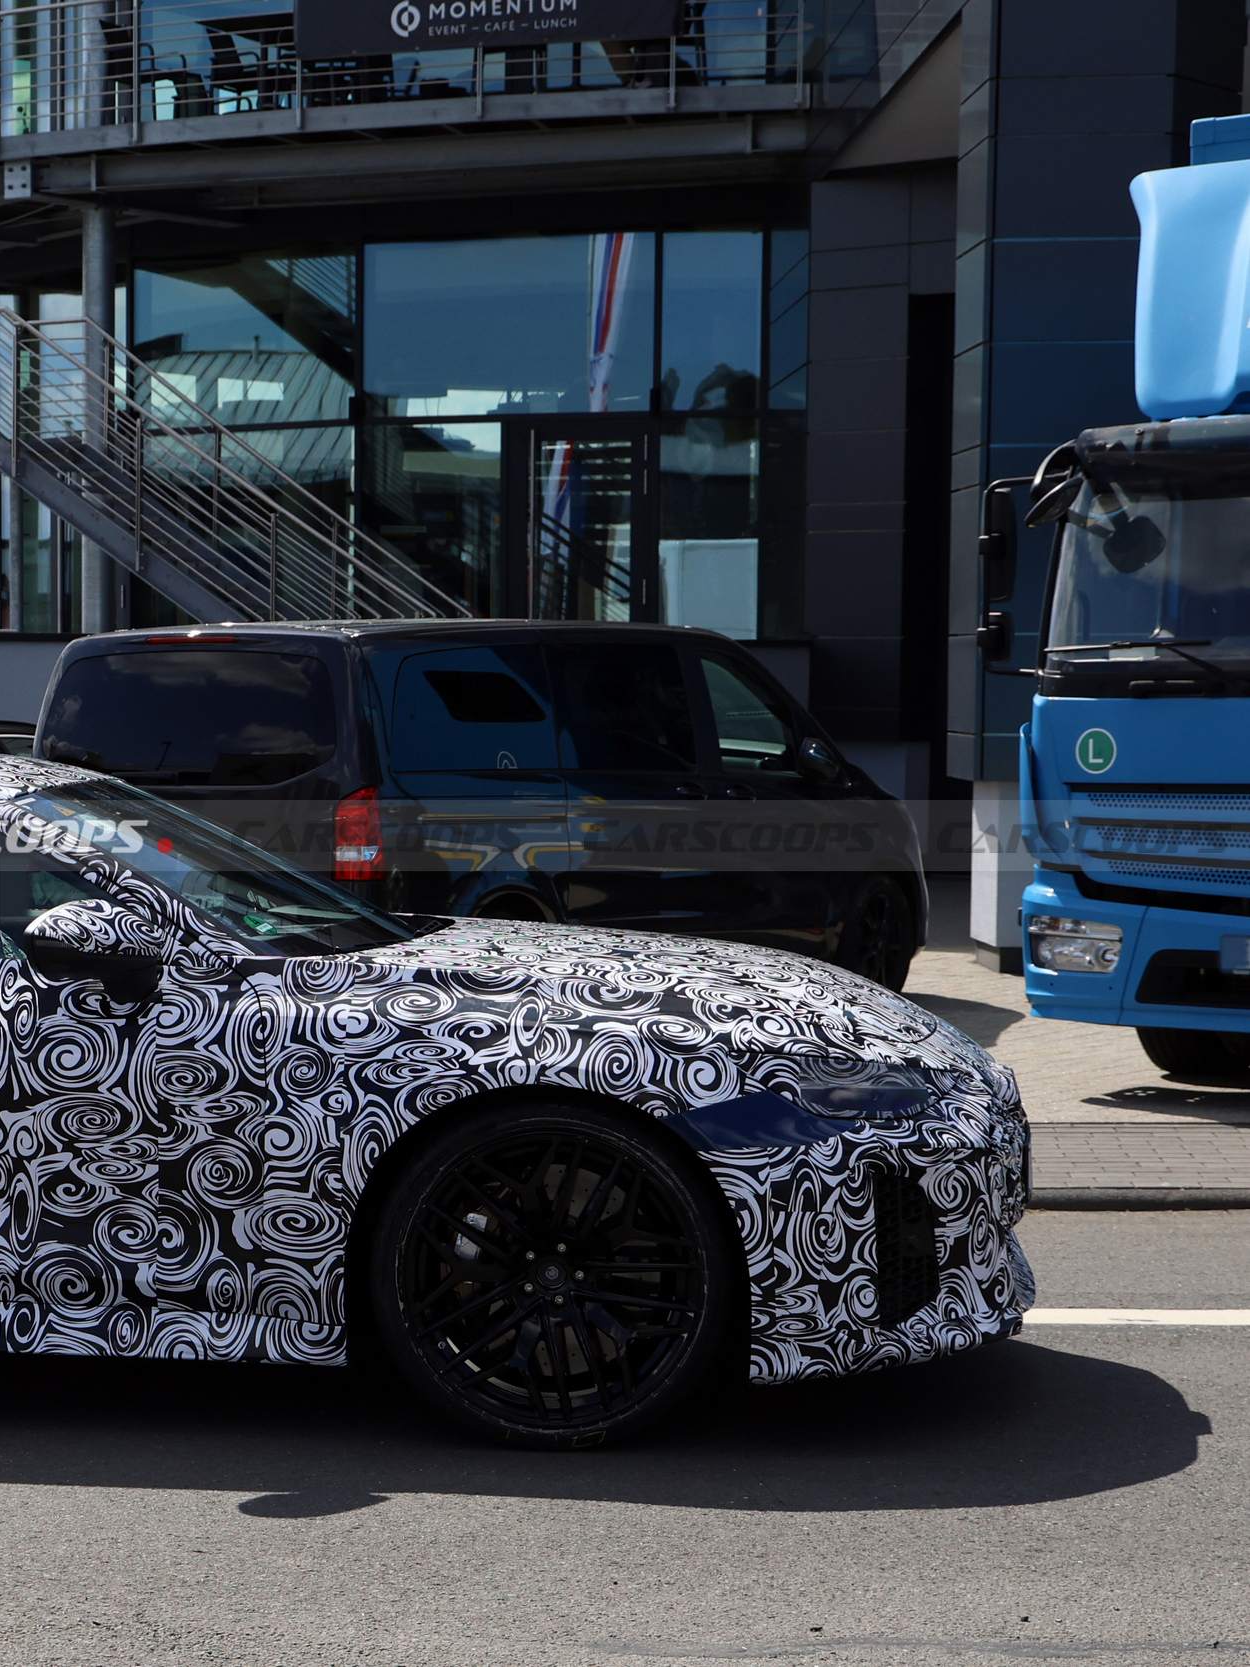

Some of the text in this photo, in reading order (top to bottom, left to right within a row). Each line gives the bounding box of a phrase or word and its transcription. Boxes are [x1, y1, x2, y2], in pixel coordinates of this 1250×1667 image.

[428, 0, 577, 20] MOMENTUM
[428, 24, 467, 36] EVENT
[484, 20, 515, 32] CAFÉ
[534, 17, 577, 30] LUNCH
[1088, 738, 1103, 763] L
